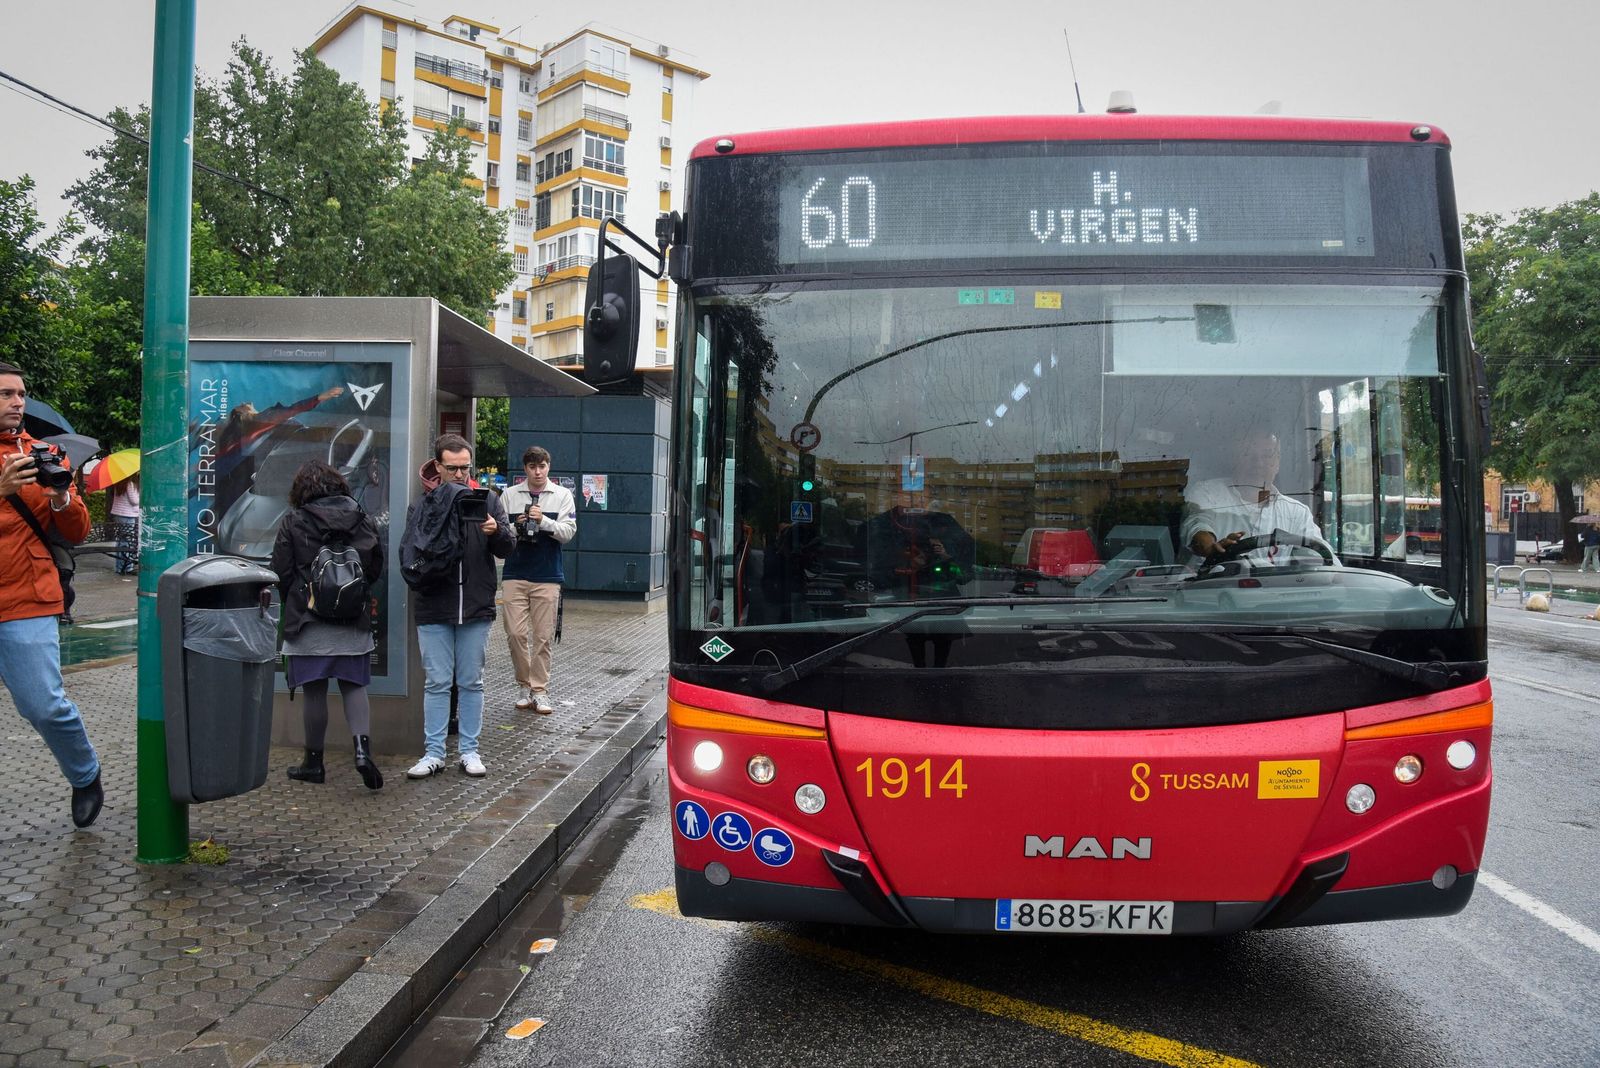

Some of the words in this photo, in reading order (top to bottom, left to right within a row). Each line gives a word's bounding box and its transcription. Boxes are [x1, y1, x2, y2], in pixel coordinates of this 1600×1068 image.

[1093, 171, 1131, 205] H.
[802, 176, 876, 248] 60
[1030, 208, 1198, 243] VIRGEN
[219, 379, 228, 419] HÍBRIDO
[198, 378, 218, 501] TERRAMAR
[705, 644, 727, 654] GNC
[856, 757, 968, 798] 1914
[1160, 773, 1249, 790] TUSSAM
[1025, 835, 1151, 859] MAN
[1018, 903, 1095, 928] 8685
[1108, 904, 1166, 930] KFK
